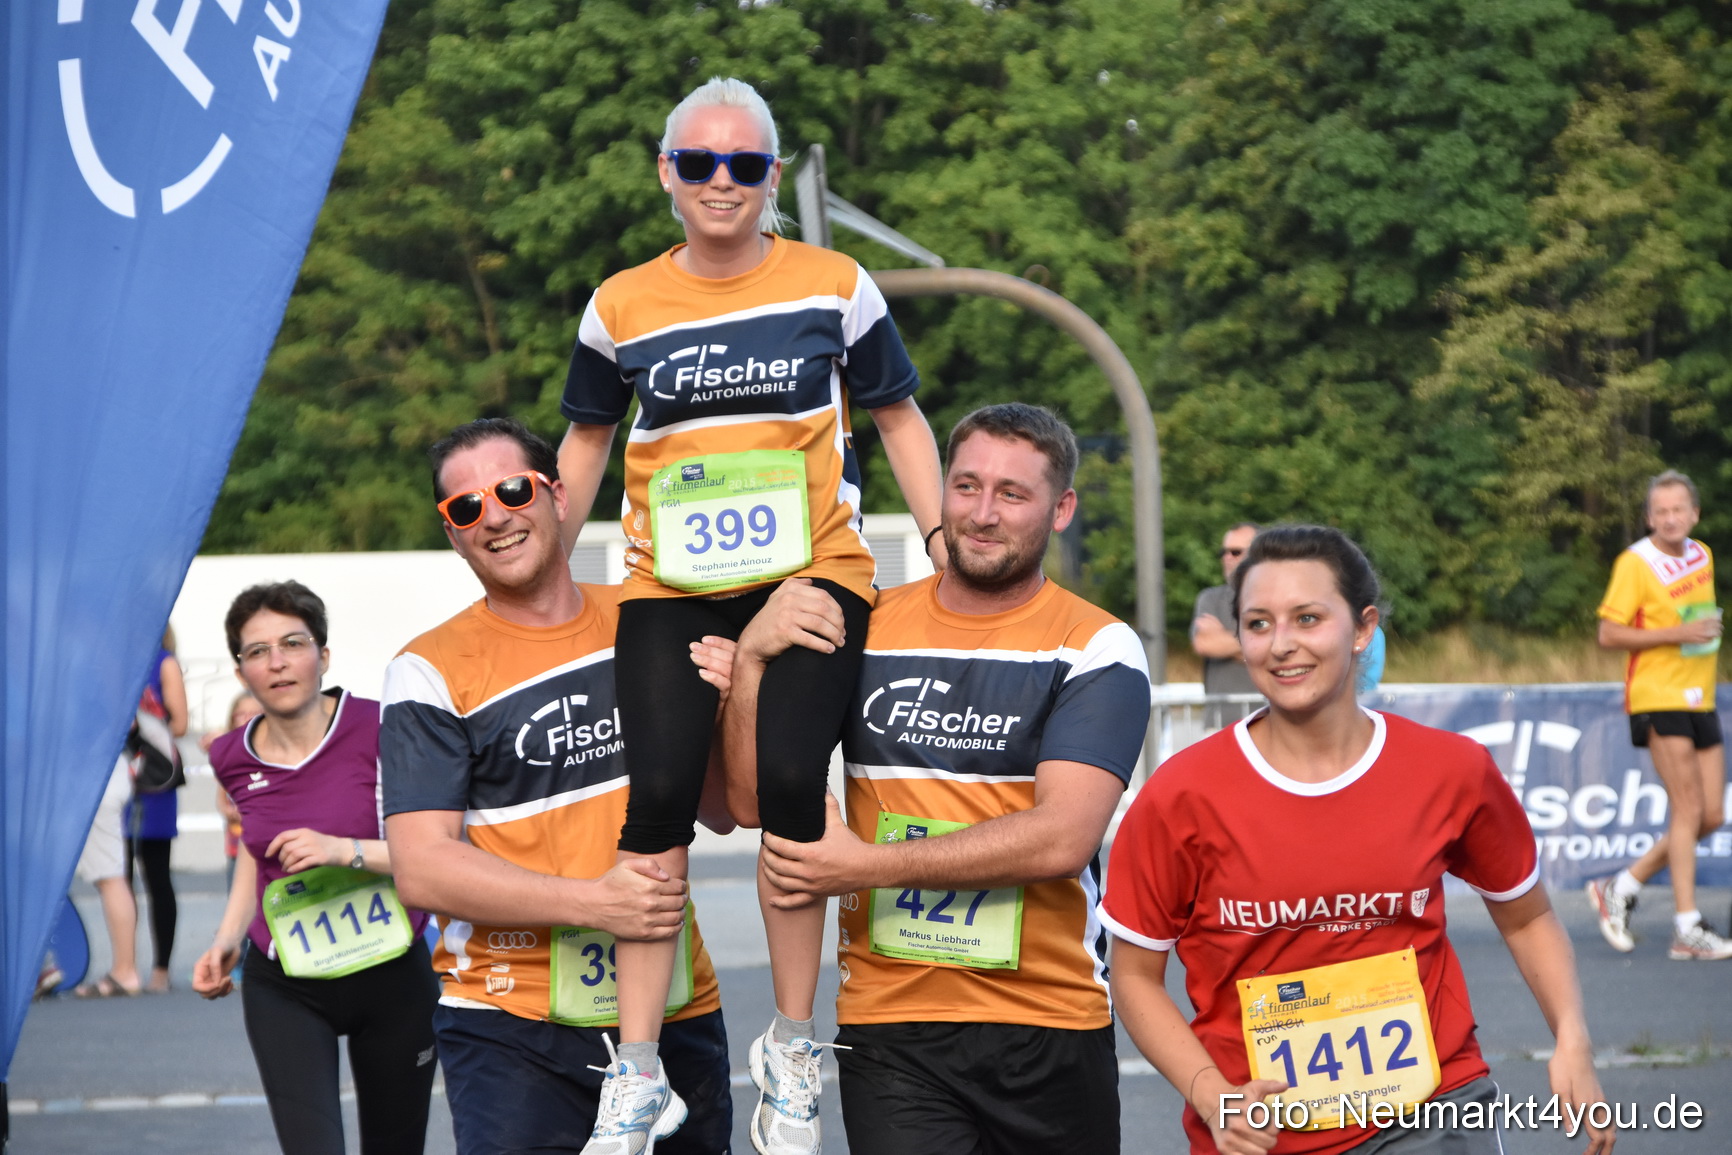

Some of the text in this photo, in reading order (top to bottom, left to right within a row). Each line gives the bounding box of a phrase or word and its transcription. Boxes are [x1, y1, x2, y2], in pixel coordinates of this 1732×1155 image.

[675, 357, 805, 392] Fischer
[690, 380, 797, 403] AUTOMOBILE
[673, 475, 725, 491] firmenlauf
[684, 504, 777, 555] 399
[692, 557, 772, 573] Stephanie Ainouz
[720, 570, 747, 578] Automobile
[887, 701, 1021, 735] Fischer
[897, 731, 1007, 751] AUTOMOBILE
[563, 740, 625, 768] AUTOM
[895, 888, 991, 927] 427
[1219, 892, 1403, 928] NEUMARKT
[289, 892, 392, 955] 1114
[1318, 918, 1397, 932] STARKE STADT
[899, 928, 981, 947] Markus Liebhardt
[313, 955, 334, 969] Birgit
[334, 937, 384, 961] Mühlenbruch
[925, 943, 953, 952] Automobile
[953, 946, 969, 954] GmbH
[595, 1006, 610, 1014] Fischer
[1268, 993, 1331, 1014] firmenlauf
[1335, 994, 1367, 1010] 2015
[1257, 1034, 1278, 1046] run
[1270, 1019, 1419, 1089] 1412
[1299, 1093, 1352, 1108] Franzisa
